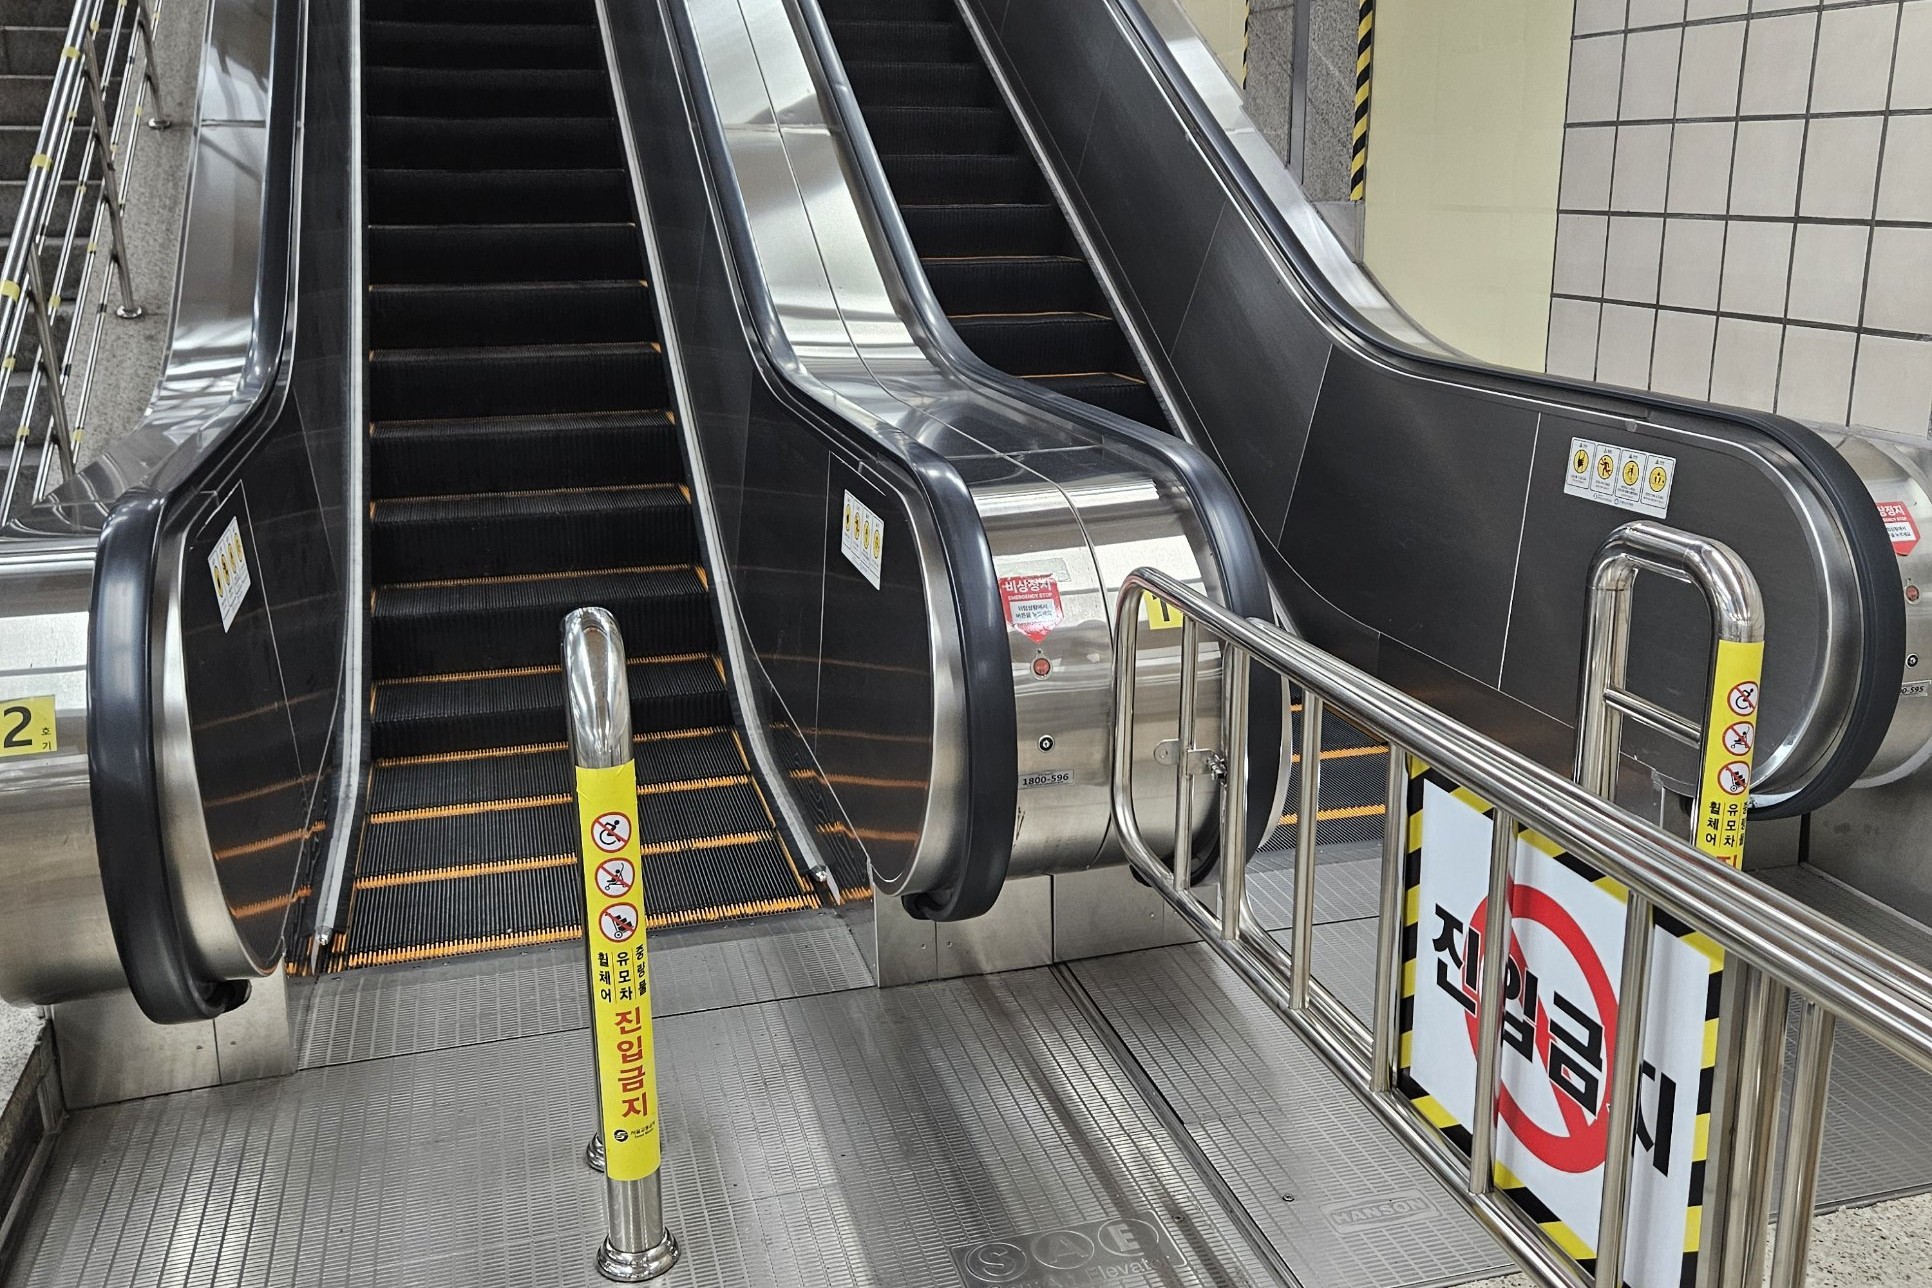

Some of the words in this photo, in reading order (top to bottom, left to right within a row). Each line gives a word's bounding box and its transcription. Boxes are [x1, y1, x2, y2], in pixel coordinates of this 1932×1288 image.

[1002, 579, 1053, 594] 비상정지
[3, 706, 33, 749] 2
[41, 727, 52, 751] 호기
[1022, 773, 1069, 786] 1800-596
[1705, 800, 1721, 846] 휠체어
[1723, 803, 1738, 848] 유모차
[597, 951, 611, 1003] 휠체어
[616, 951, 633, 1001] 유모차
[635, 943, 647, 997] 중량물
[615, 1006, 648, 1118] 진입금지
